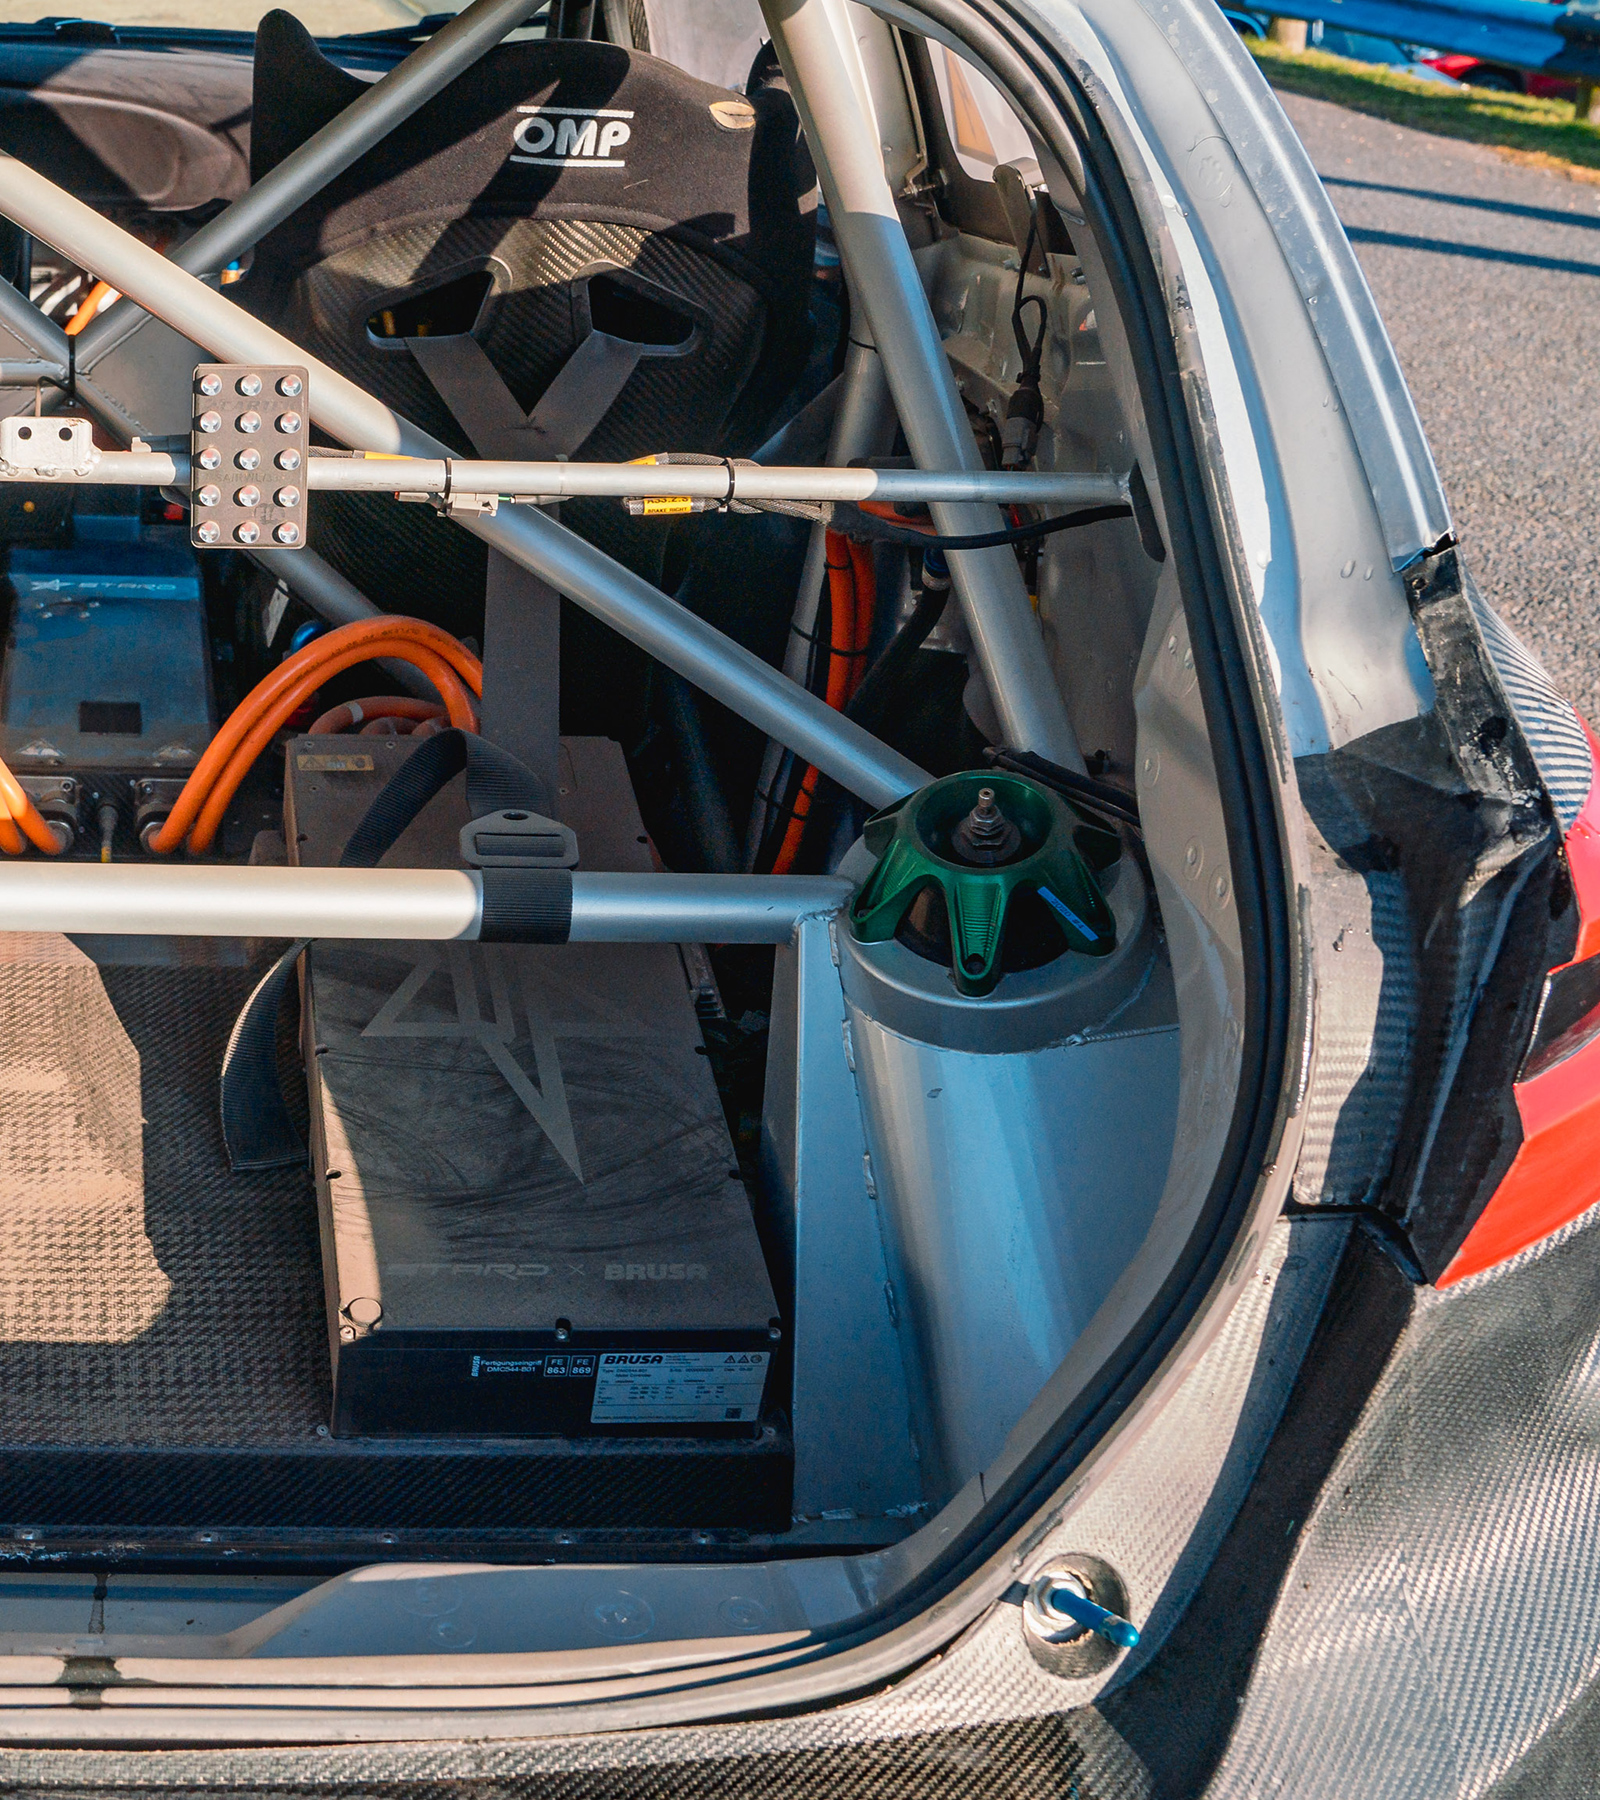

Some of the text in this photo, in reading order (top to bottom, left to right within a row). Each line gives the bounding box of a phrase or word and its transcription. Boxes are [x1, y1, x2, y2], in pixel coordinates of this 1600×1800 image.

[513, 117, 631, 157] OMP
[1050, 898, 1072, 917] 2020
[604, 1263, 709, 1280] BRUSA
[481, 1359, 543, 1367] Fertigungseingriff
[604, 1355, 663, 1365] BRUSA
